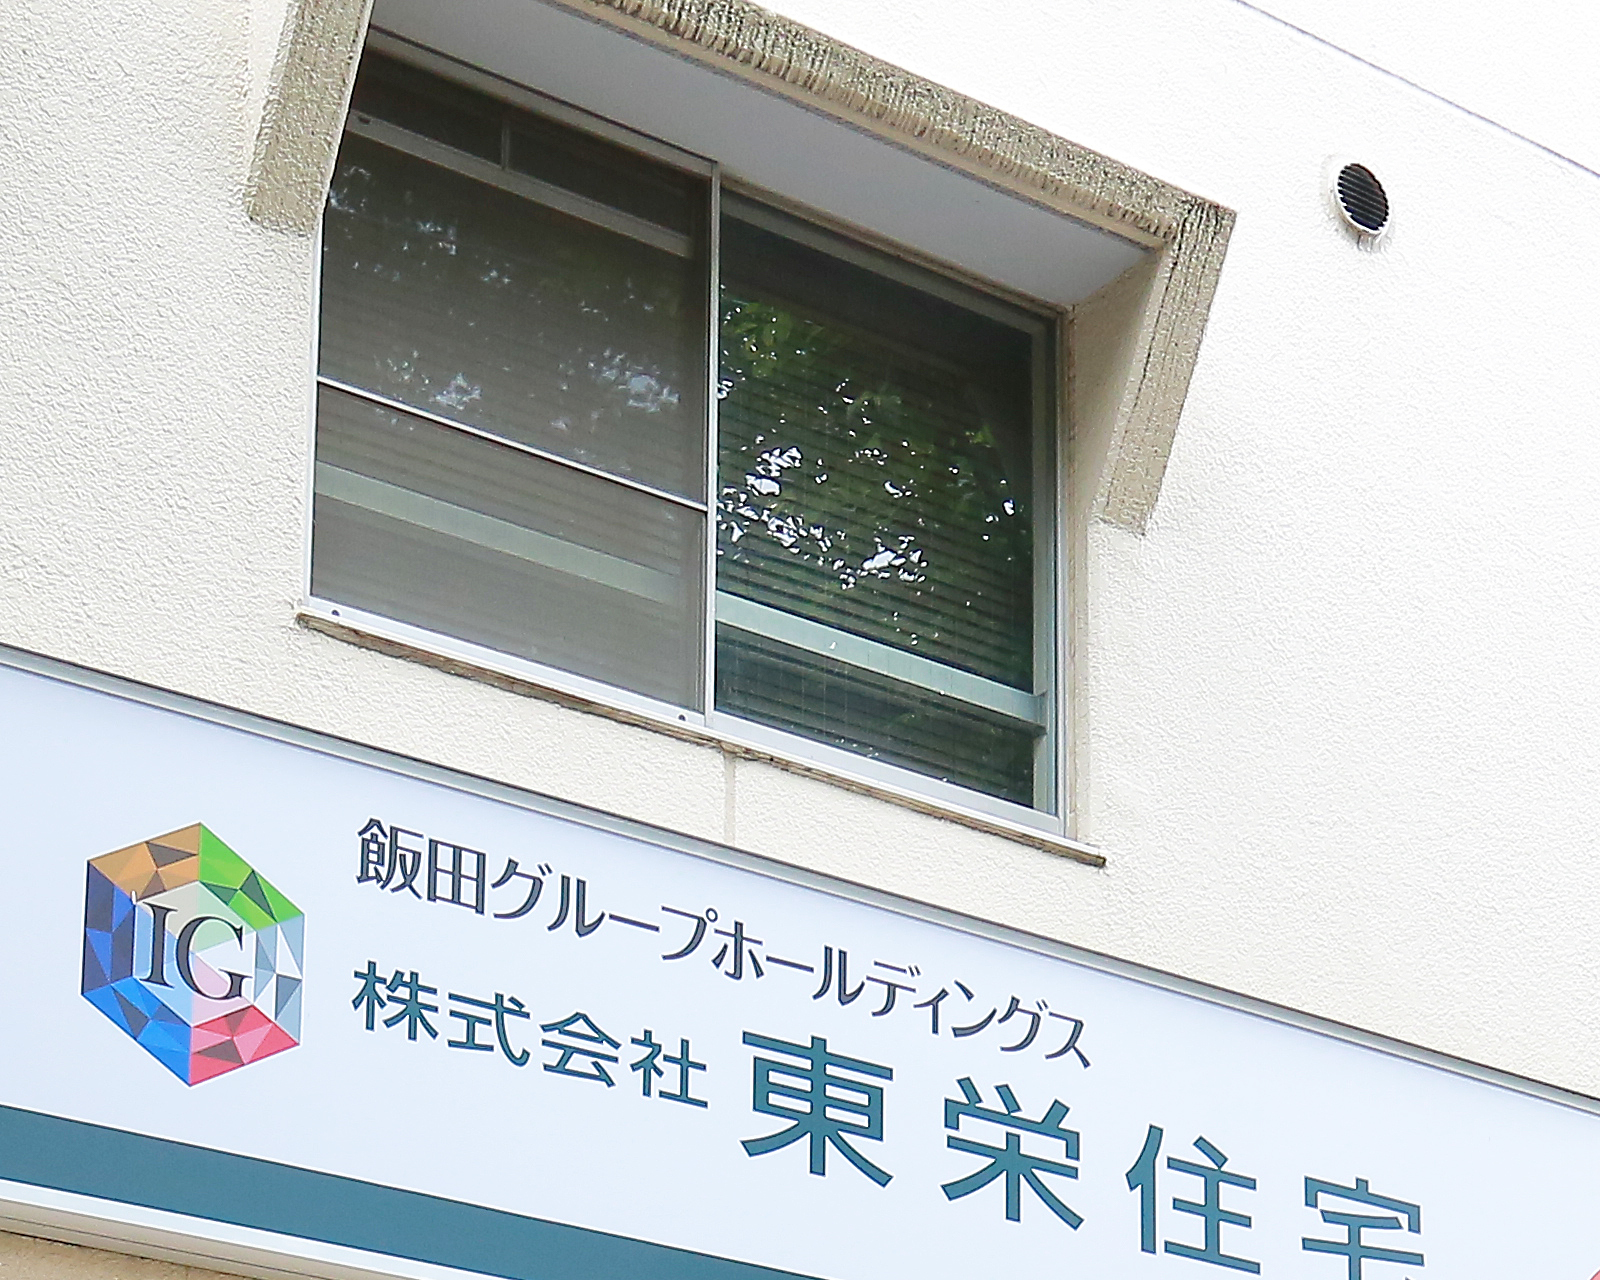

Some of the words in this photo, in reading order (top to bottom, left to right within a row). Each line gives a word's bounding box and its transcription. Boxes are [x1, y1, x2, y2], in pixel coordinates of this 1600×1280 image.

[145, 890, 252, 1003] IG
[357, 818, 1092, 1072] 飯田グループホールディングス
